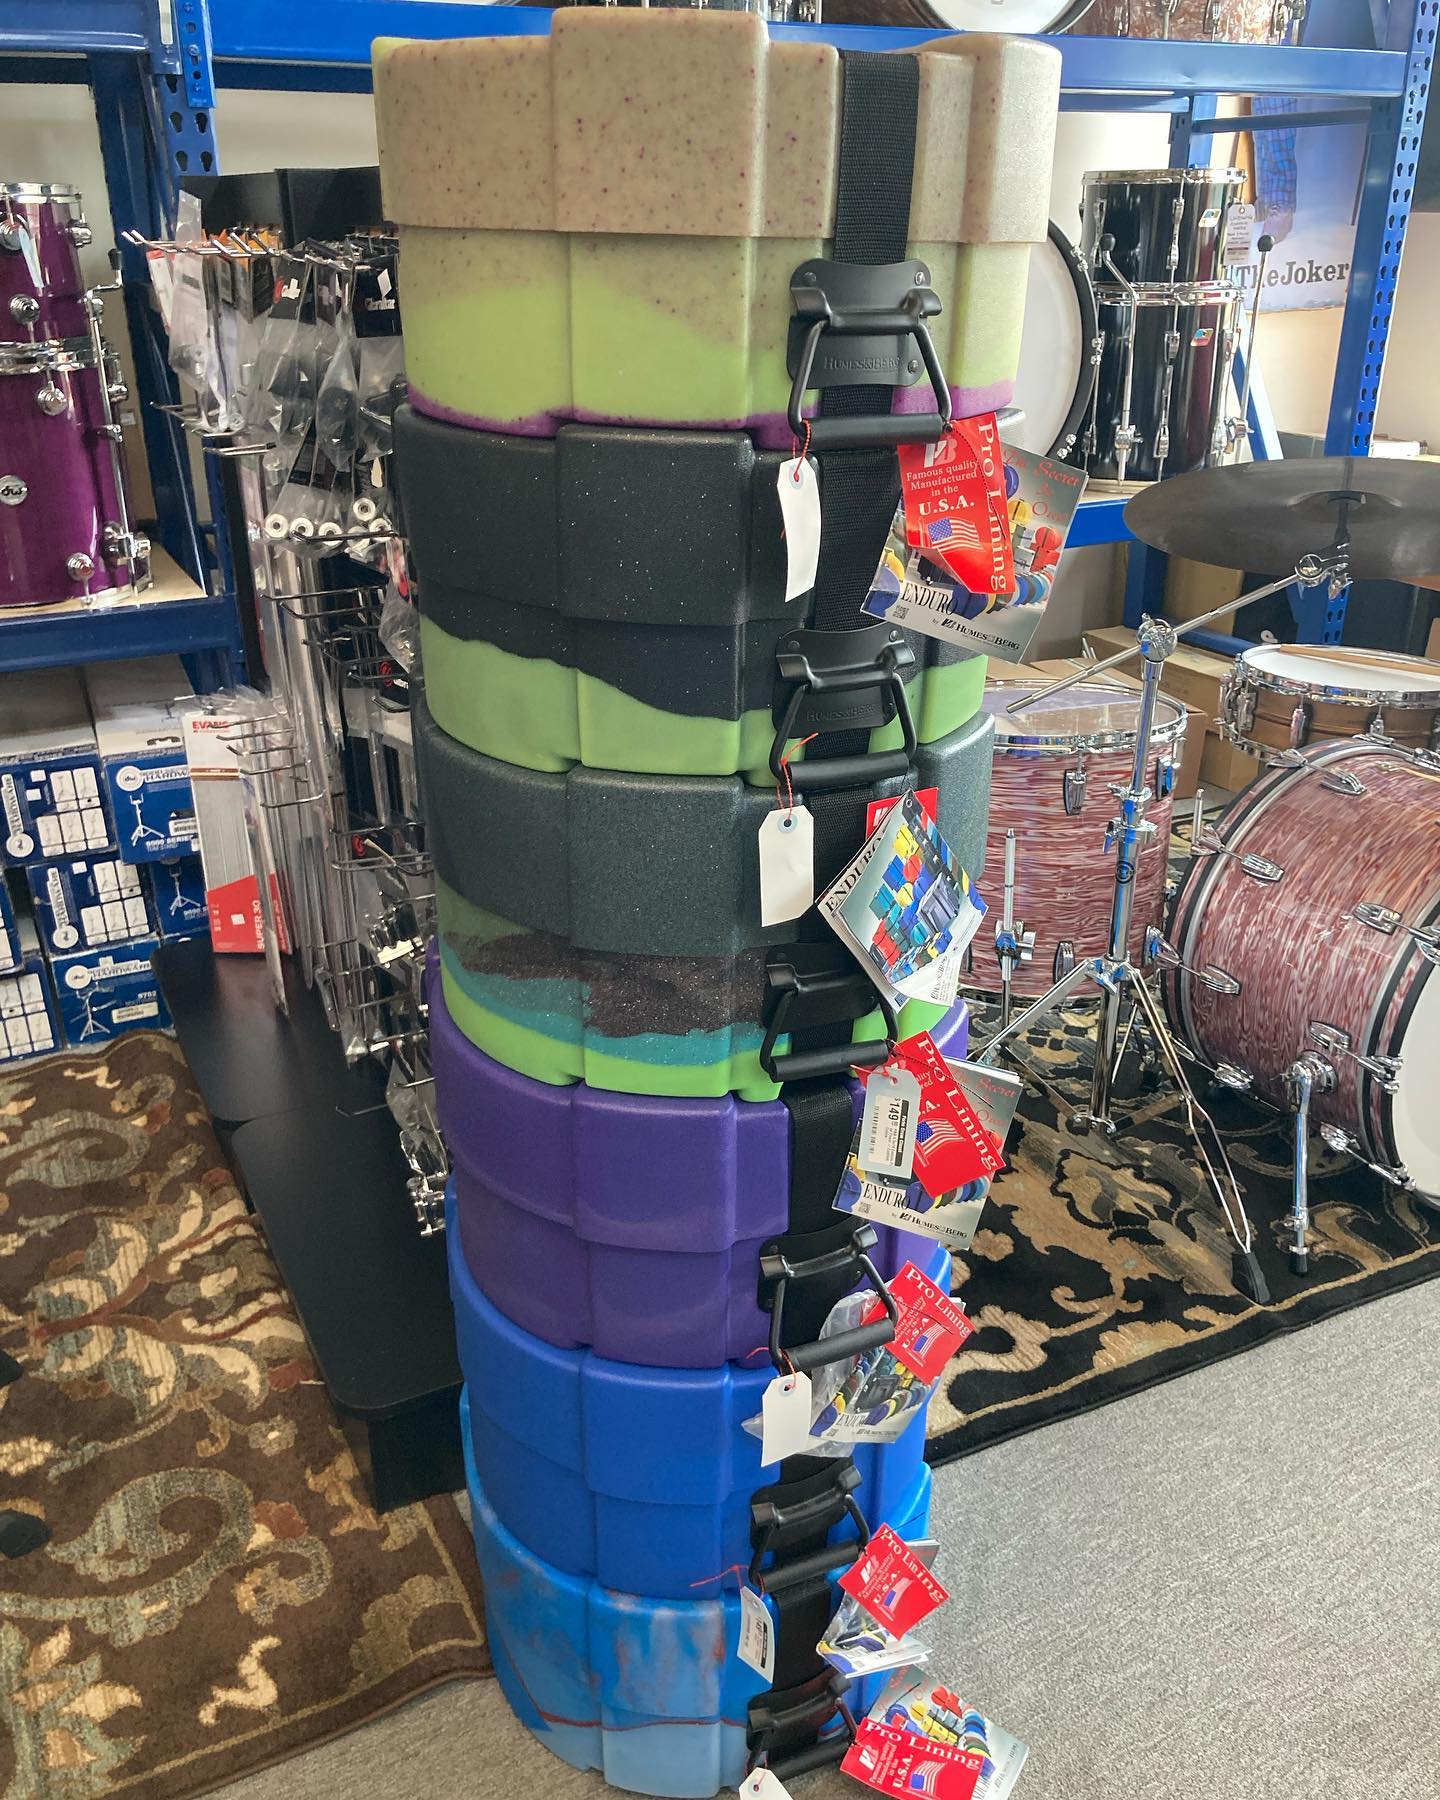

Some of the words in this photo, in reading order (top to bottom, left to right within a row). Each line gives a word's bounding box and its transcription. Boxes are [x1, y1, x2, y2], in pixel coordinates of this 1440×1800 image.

[978, 423, 996, 478] Pro
[906, 467, 944, 482] Famous
[946, 460, 980, 475] quality
[911, 471, 978, 490] Manufactured
[918, 495, 975, 516] U.S.A.
[931, 488, 941, 498] in
[943, 485, 959, 495] the
[986, 487, 1008, 592] Lining
[901, 583, 958, 616] ENDURO
[917, 1039, 946, 1083] Pro
[945, 1087, 997, 1171] Lining
[863, 1183, 911, 1210] ENDURO
[906, 1267, 935, 1298] Pro
[935, 1299, 972, 1337] Lining
[880, 1529, 903, 1554] Pro
[902, 1552, 945, 1604] Lining
[864, 1722, 902, 1743] Pro
[909, 1736, 982, 1771] Lining
[892, 1754, 914, 1788] U.S.A.
